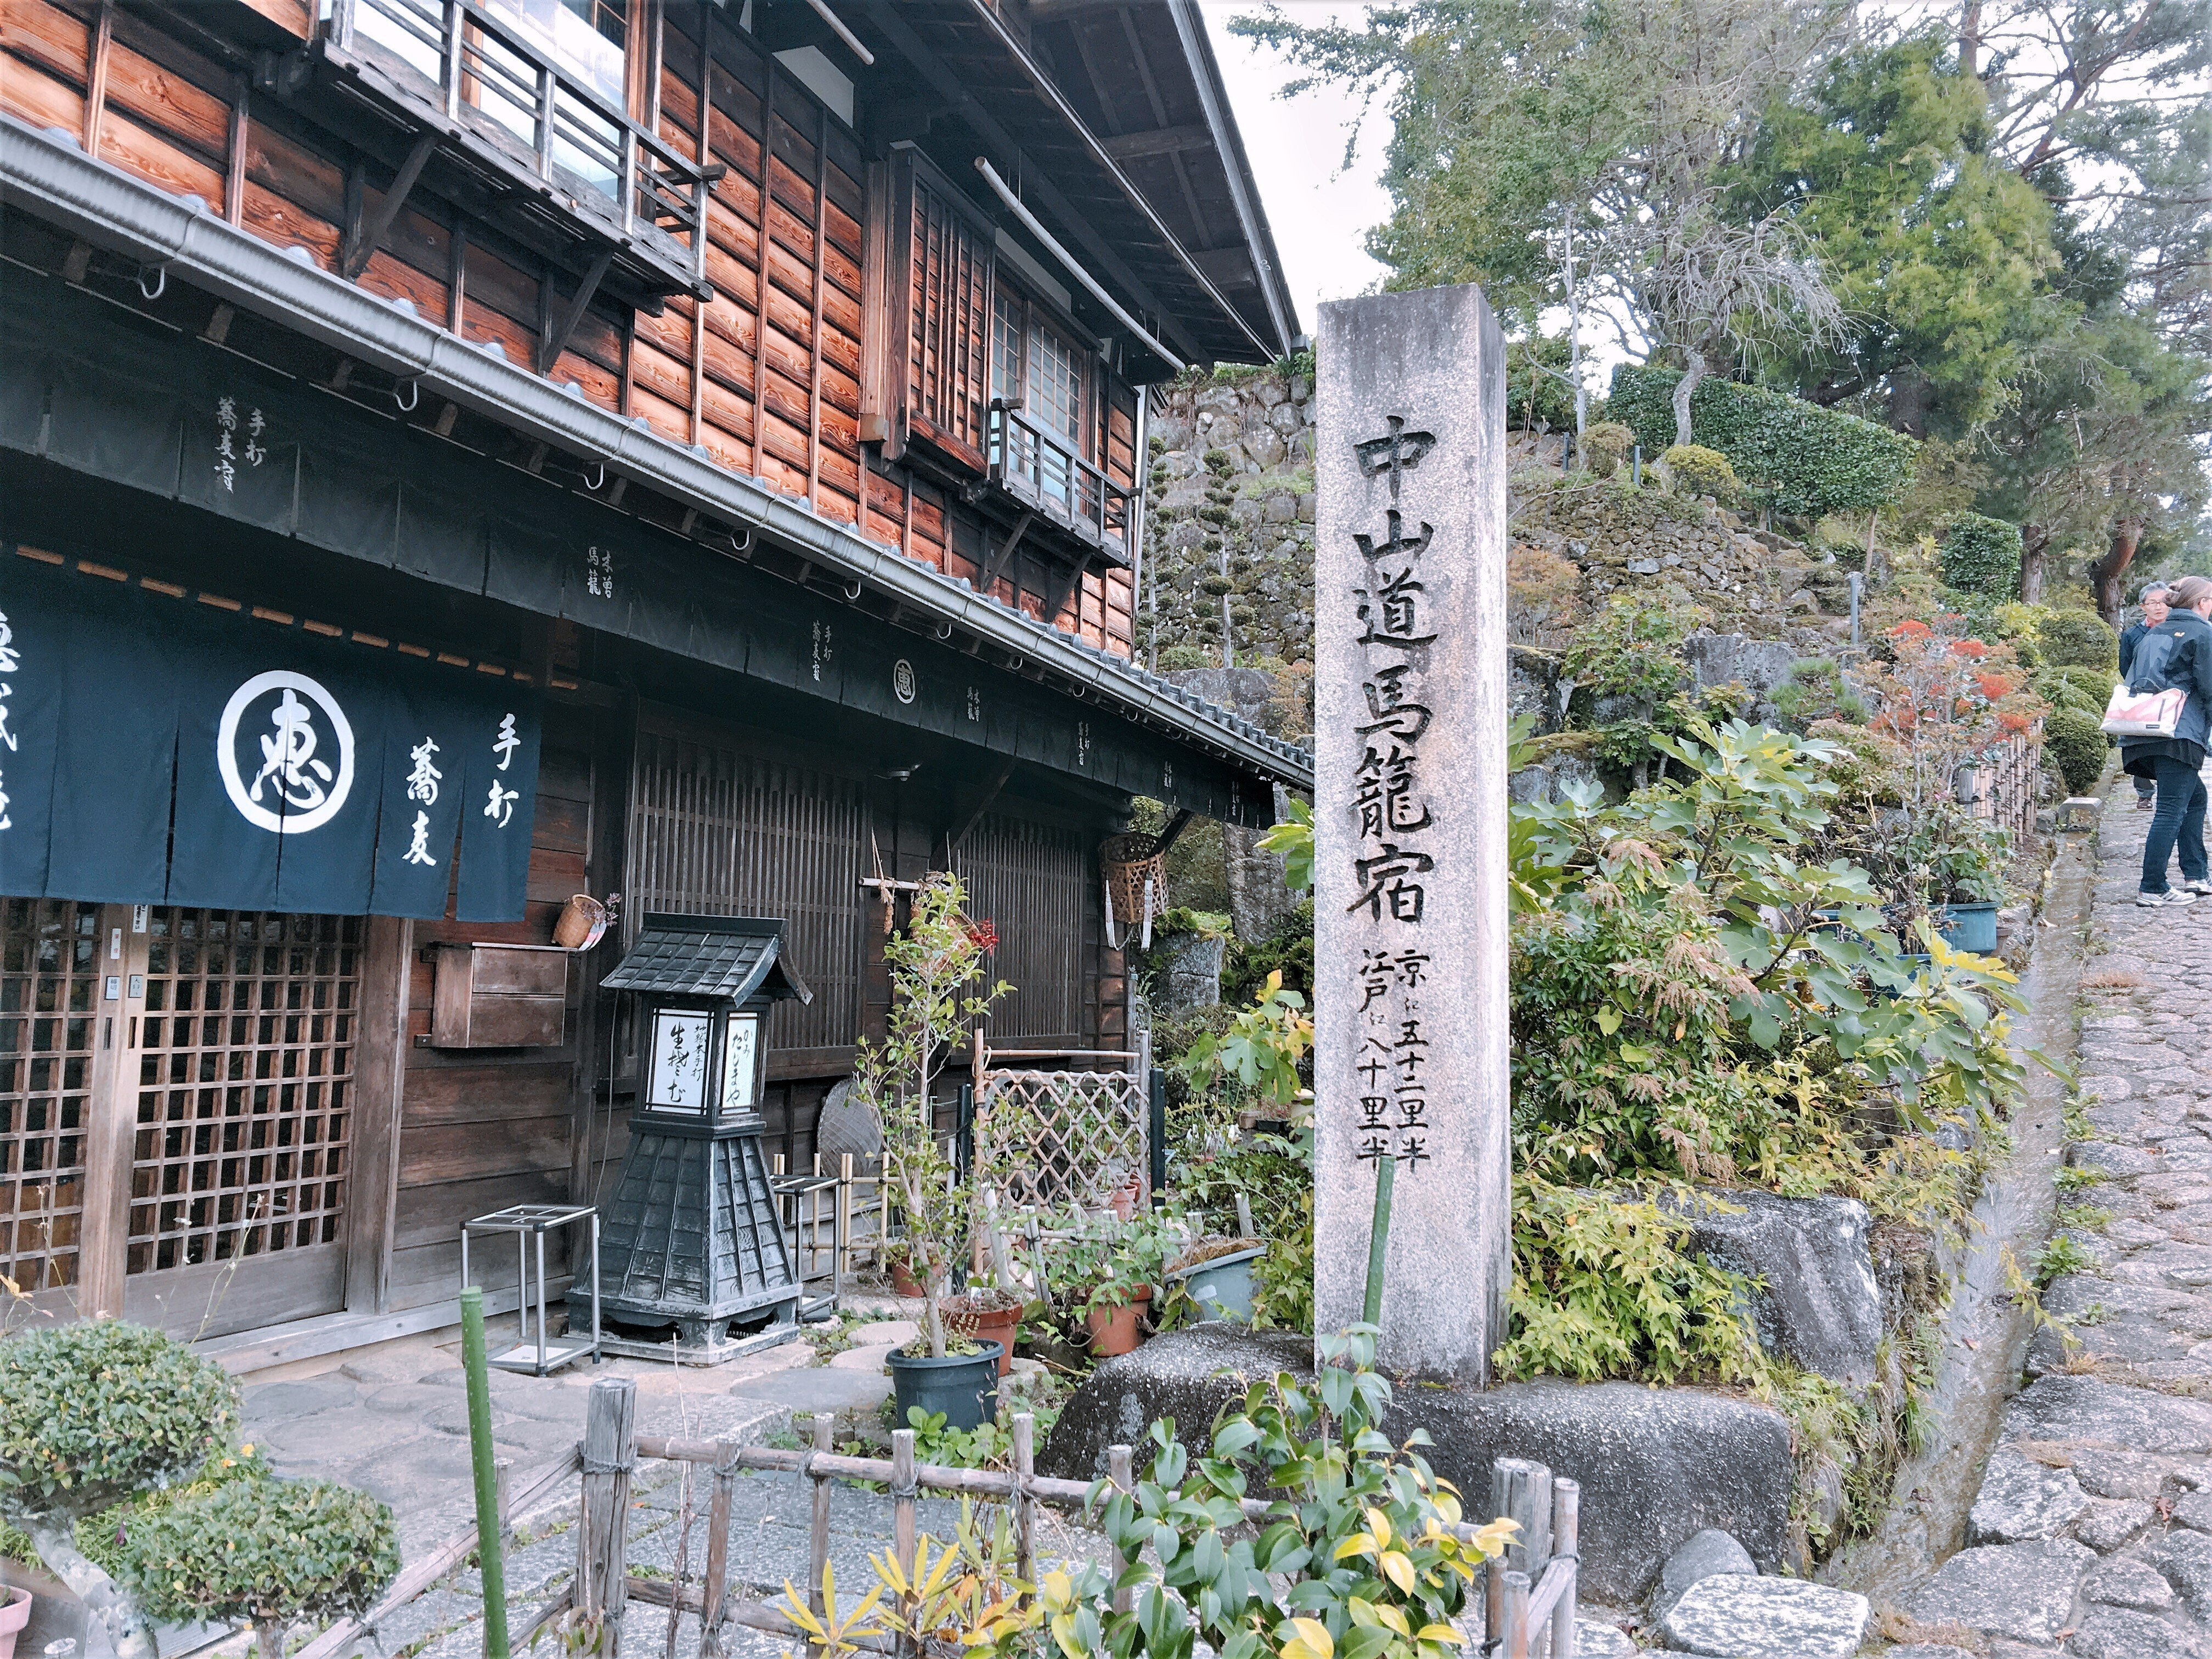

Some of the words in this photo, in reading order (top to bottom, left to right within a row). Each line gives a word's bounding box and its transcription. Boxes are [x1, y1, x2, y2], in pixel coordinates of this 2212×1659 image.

[245, 407, 267, 467] 手打
[586, 546, 601, 595] 馬籠
[1346, 415, 1438, 923] 中山道馬籠宿
[402, 736, 443, 867] 蕎麦
[483, 713, 521, 828] 手打
